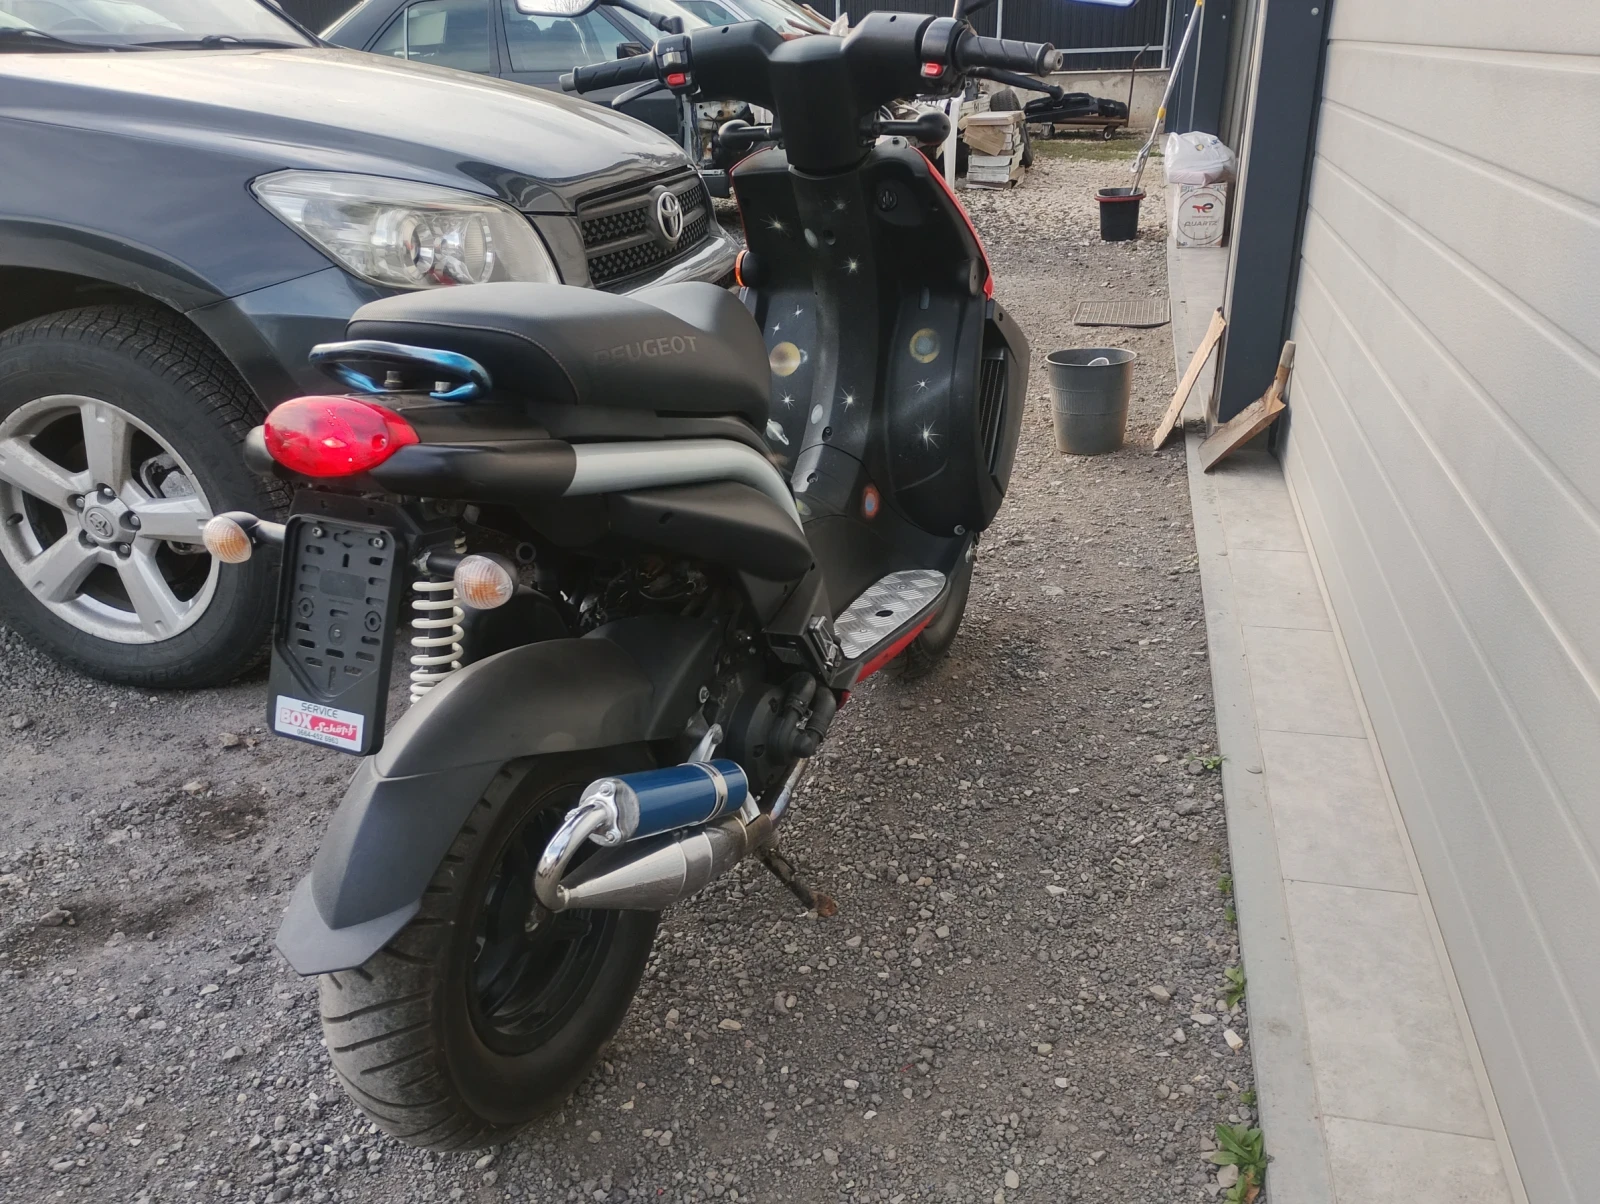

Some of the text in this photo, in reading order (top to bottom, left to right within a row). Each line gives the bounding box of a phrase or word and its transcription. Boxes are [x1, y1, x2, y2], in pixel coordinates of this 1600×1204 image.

[1184, 220, 1218, 228] QUARTZ
[592, 335, 698, 366] PEUGEOT
[280, 707, 313, 730] BOX
[301, 702, 339, 719] SERVICE
